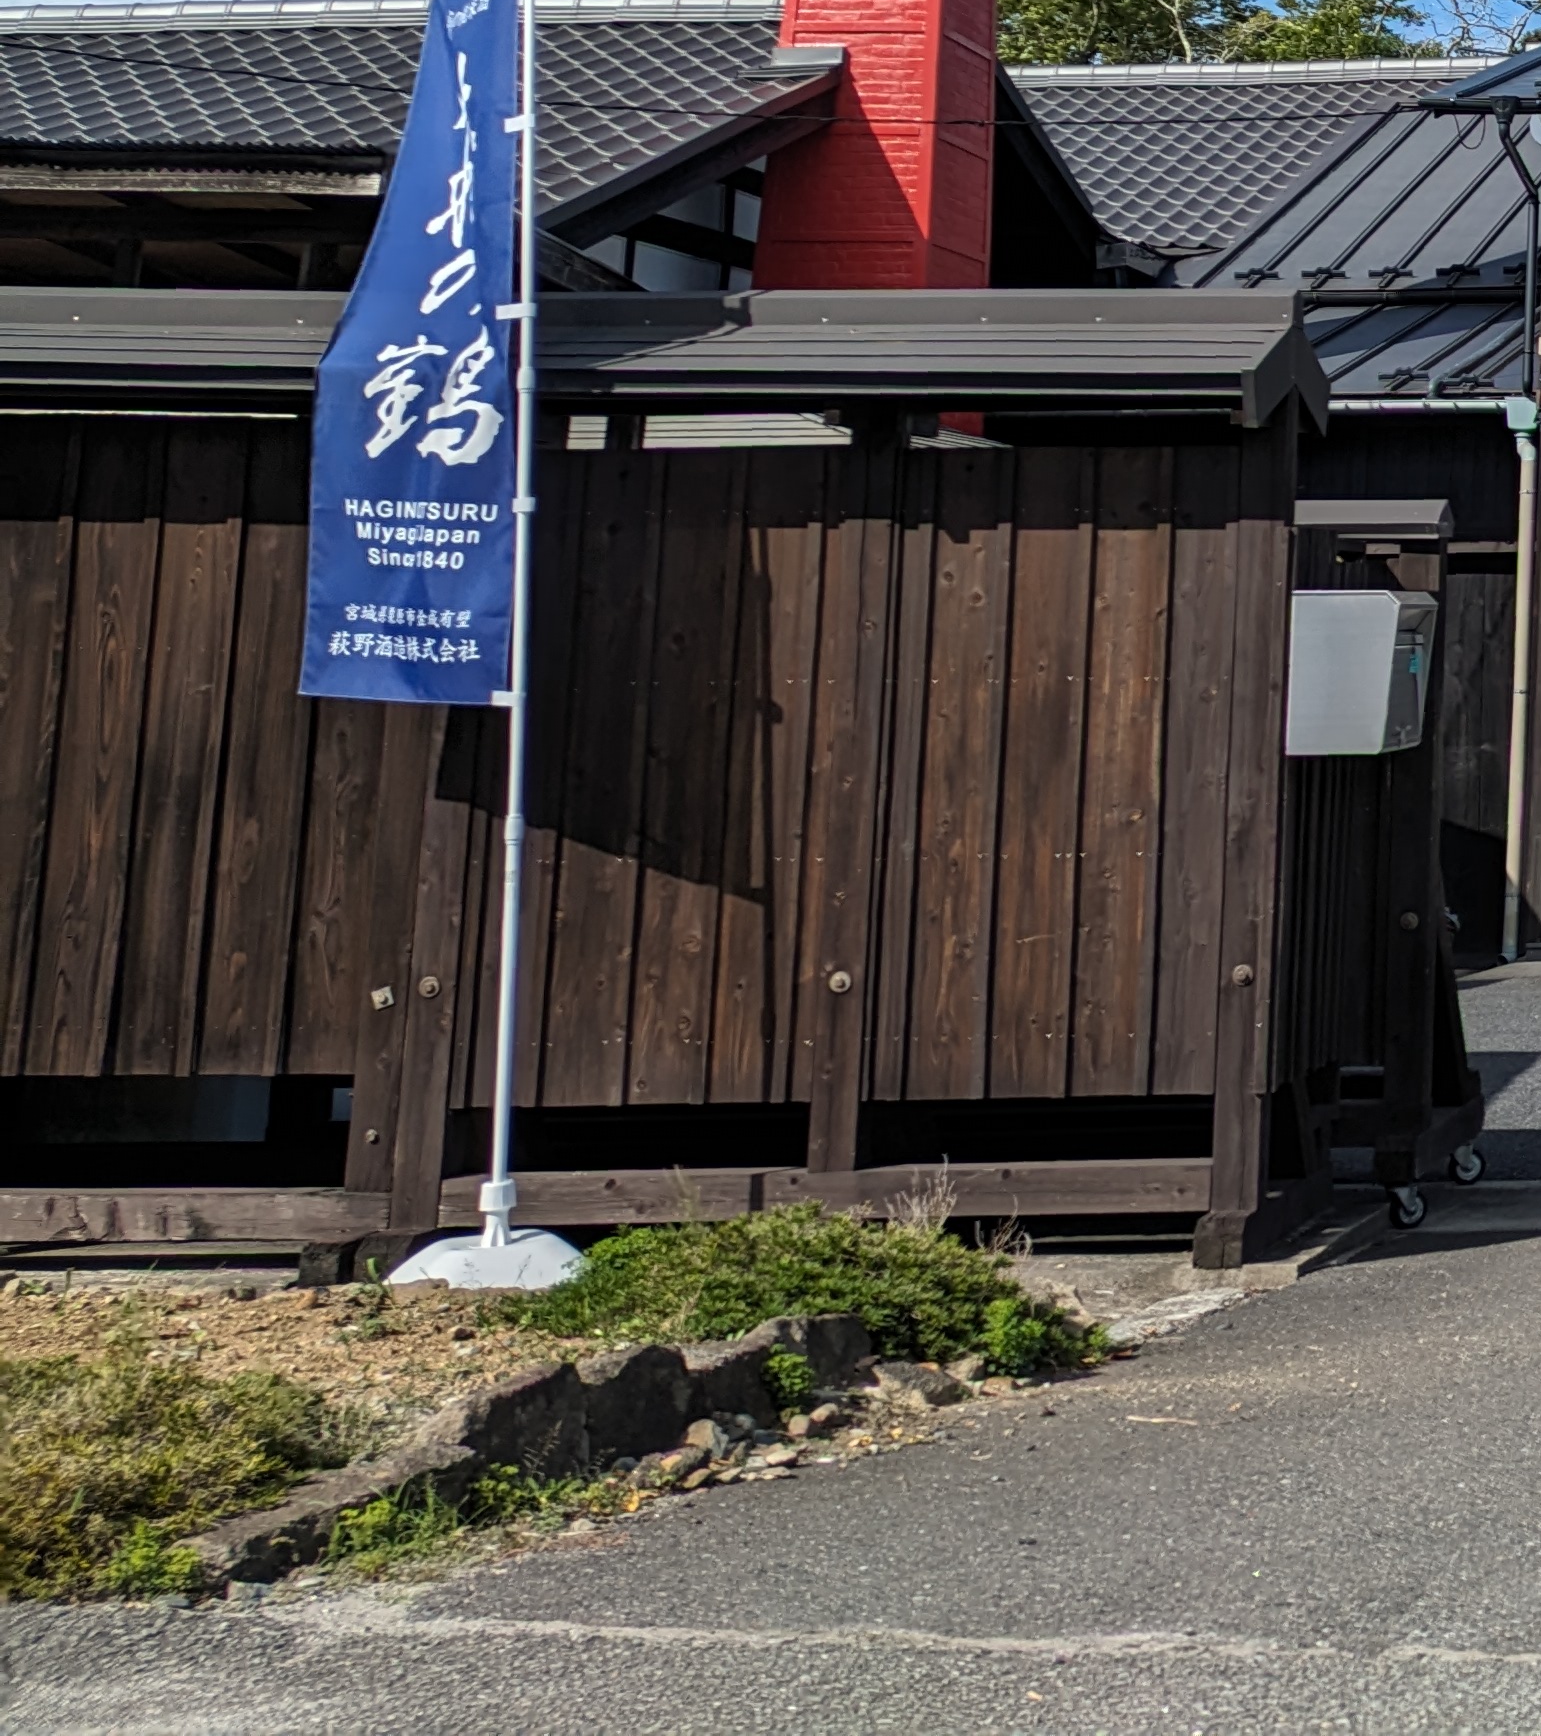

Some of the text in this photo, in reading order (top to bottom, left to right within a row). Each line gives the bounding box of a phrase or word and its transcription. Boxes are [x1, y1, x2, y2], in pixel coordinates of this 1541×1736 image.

[344, 498, 499, 522] HAGINTSURU
[416, 550, 464, 570] 1840
[328, 630, 481, 663] 萩野酒造株式会社
